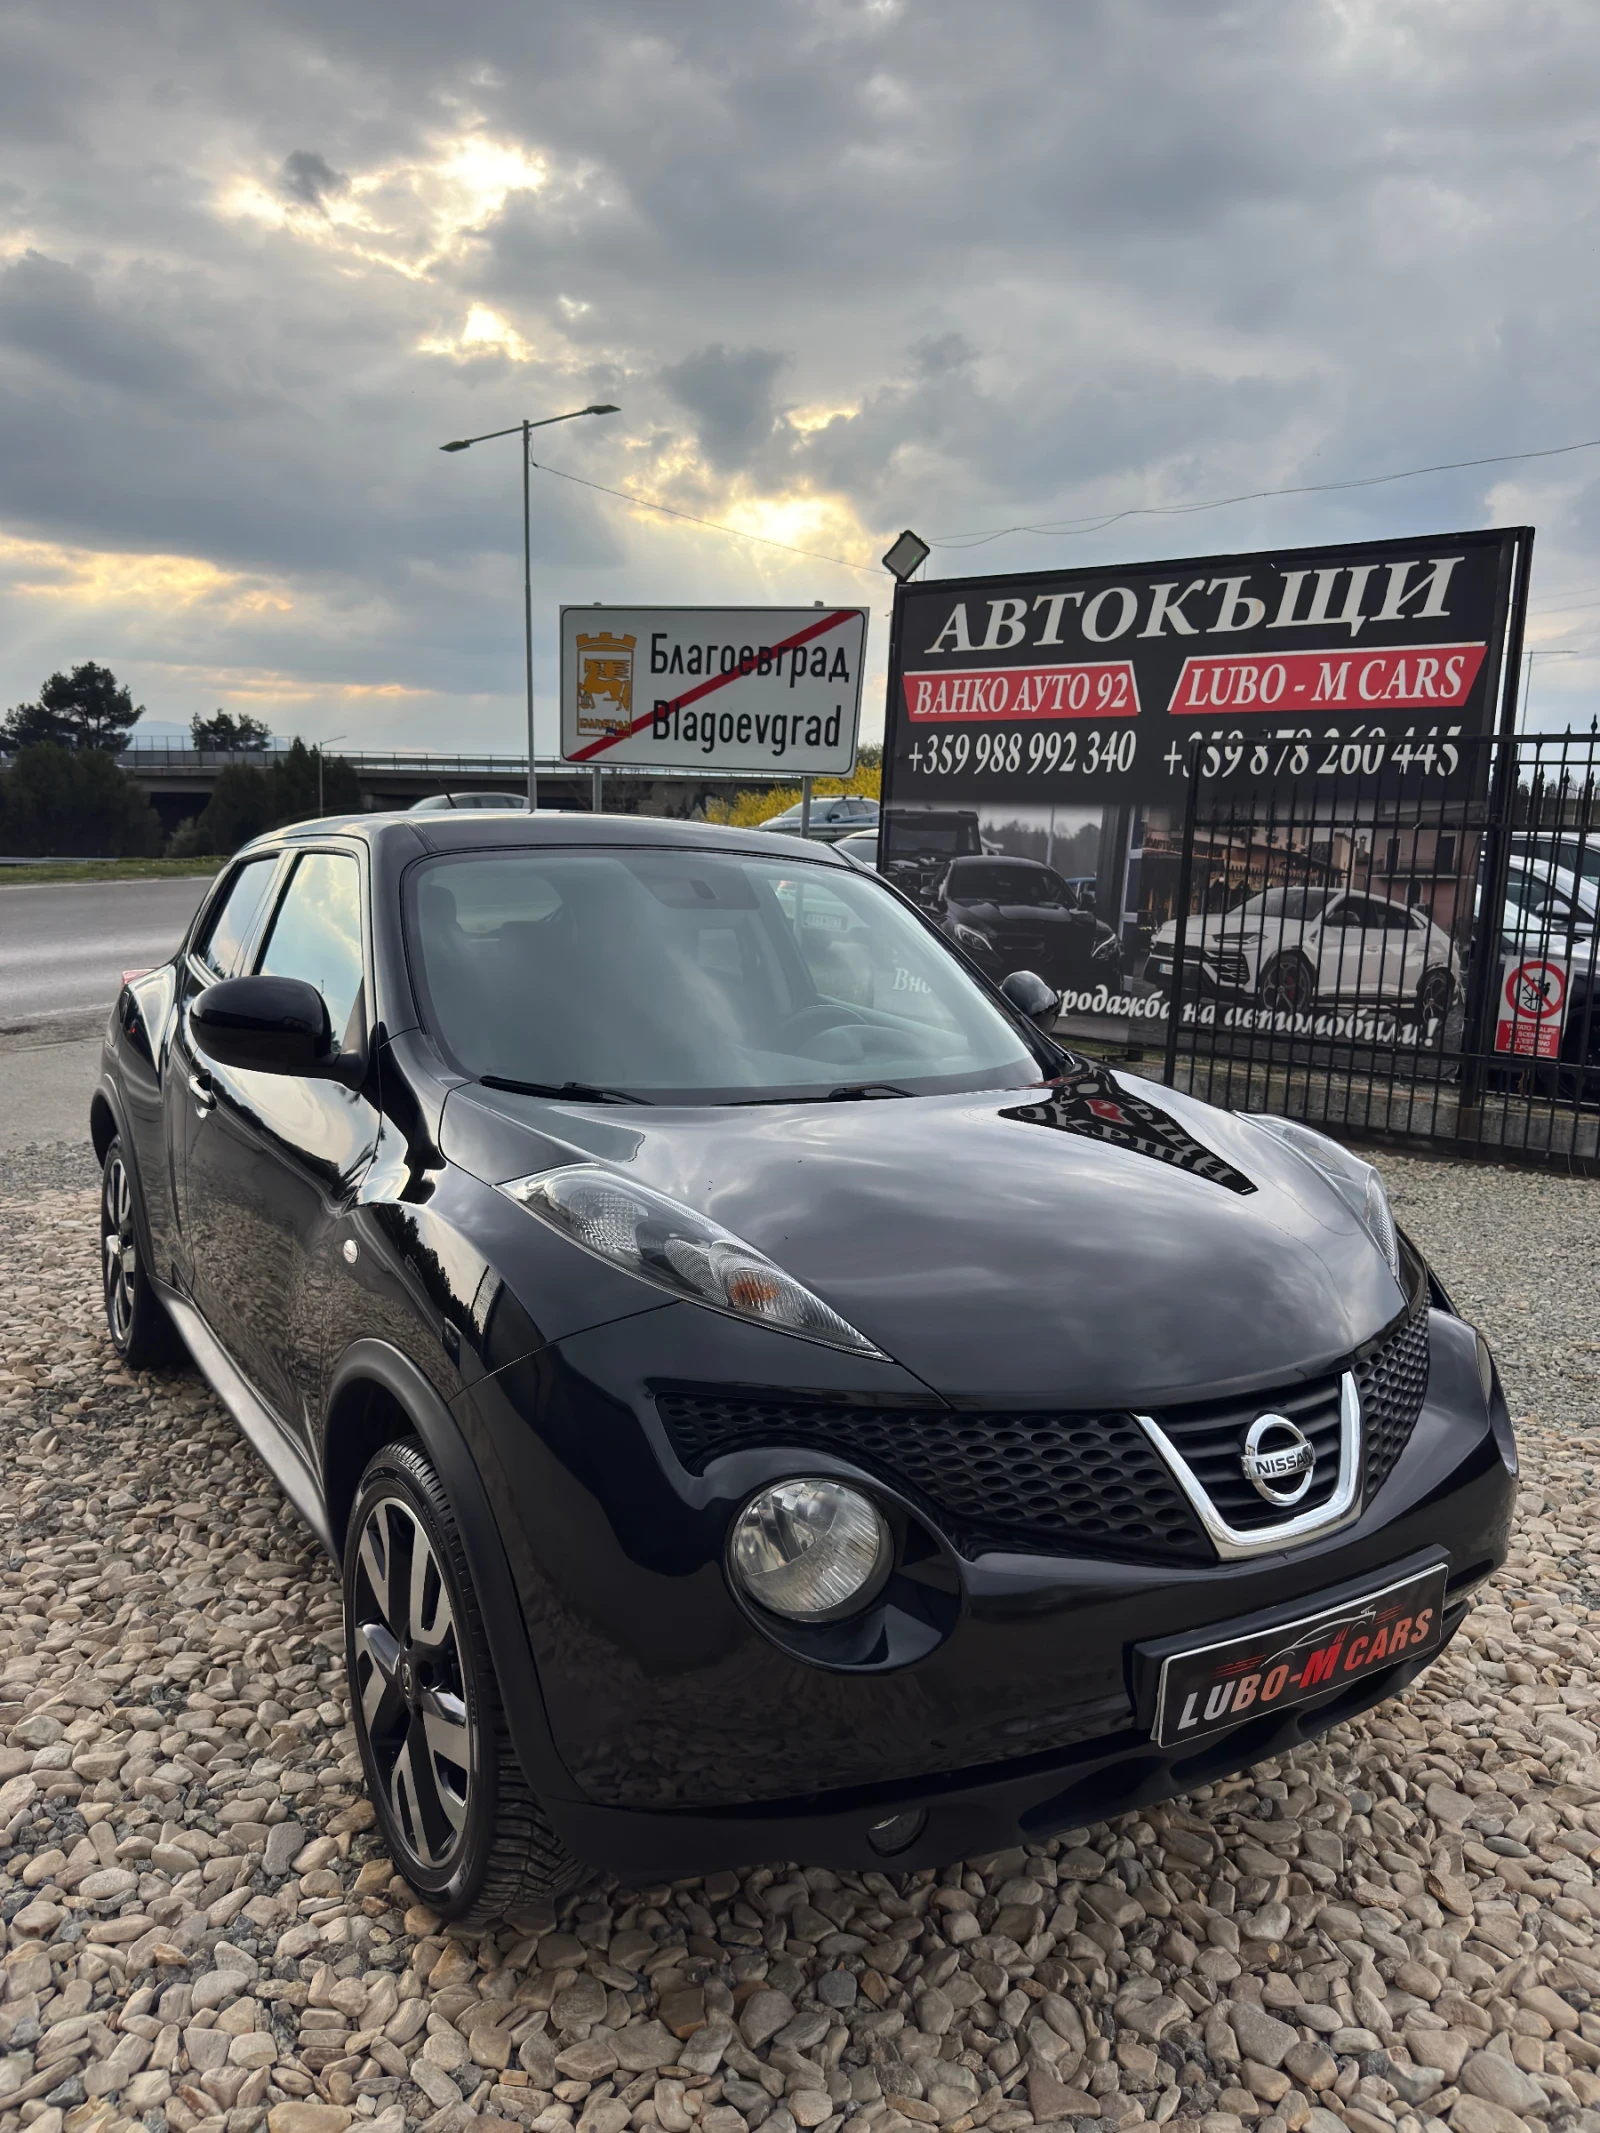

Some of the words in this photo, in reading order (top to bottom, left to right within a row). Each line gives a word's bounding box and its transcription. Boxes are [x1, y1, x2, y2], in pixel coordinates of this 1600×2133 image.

[924, 556, 1465, 654] АВТОКЪЩИ
[650, 633, 850, 688] Благоевград
[1184, 663, 1286, 707] LUBO
[1310, 661, 1352, 702] M
[1358, 655, 1465, 700] CARS
[913, 677, 1009, 714] ВАНКО
[1010, 673, 1090, 713] АУТО
[1096, 671, 1128, 710] 92
[652, 700, 841, 756] Blagoevgrad
[908, 734, 970, 775] +359
[973, 732, 1023, 775] 988
[1026, 731, 1078, 775] 992
[1082, 730, 1136, 774] 340
[1316, 724, 1386, 775] 260
[1390, 725, 1463, 777] 445
[1056, 984, 1171, 1020] родажба
[1255, 1445, 1314, 1475] NISSAN
[1344, 1607, 1433, 1671] CARS
